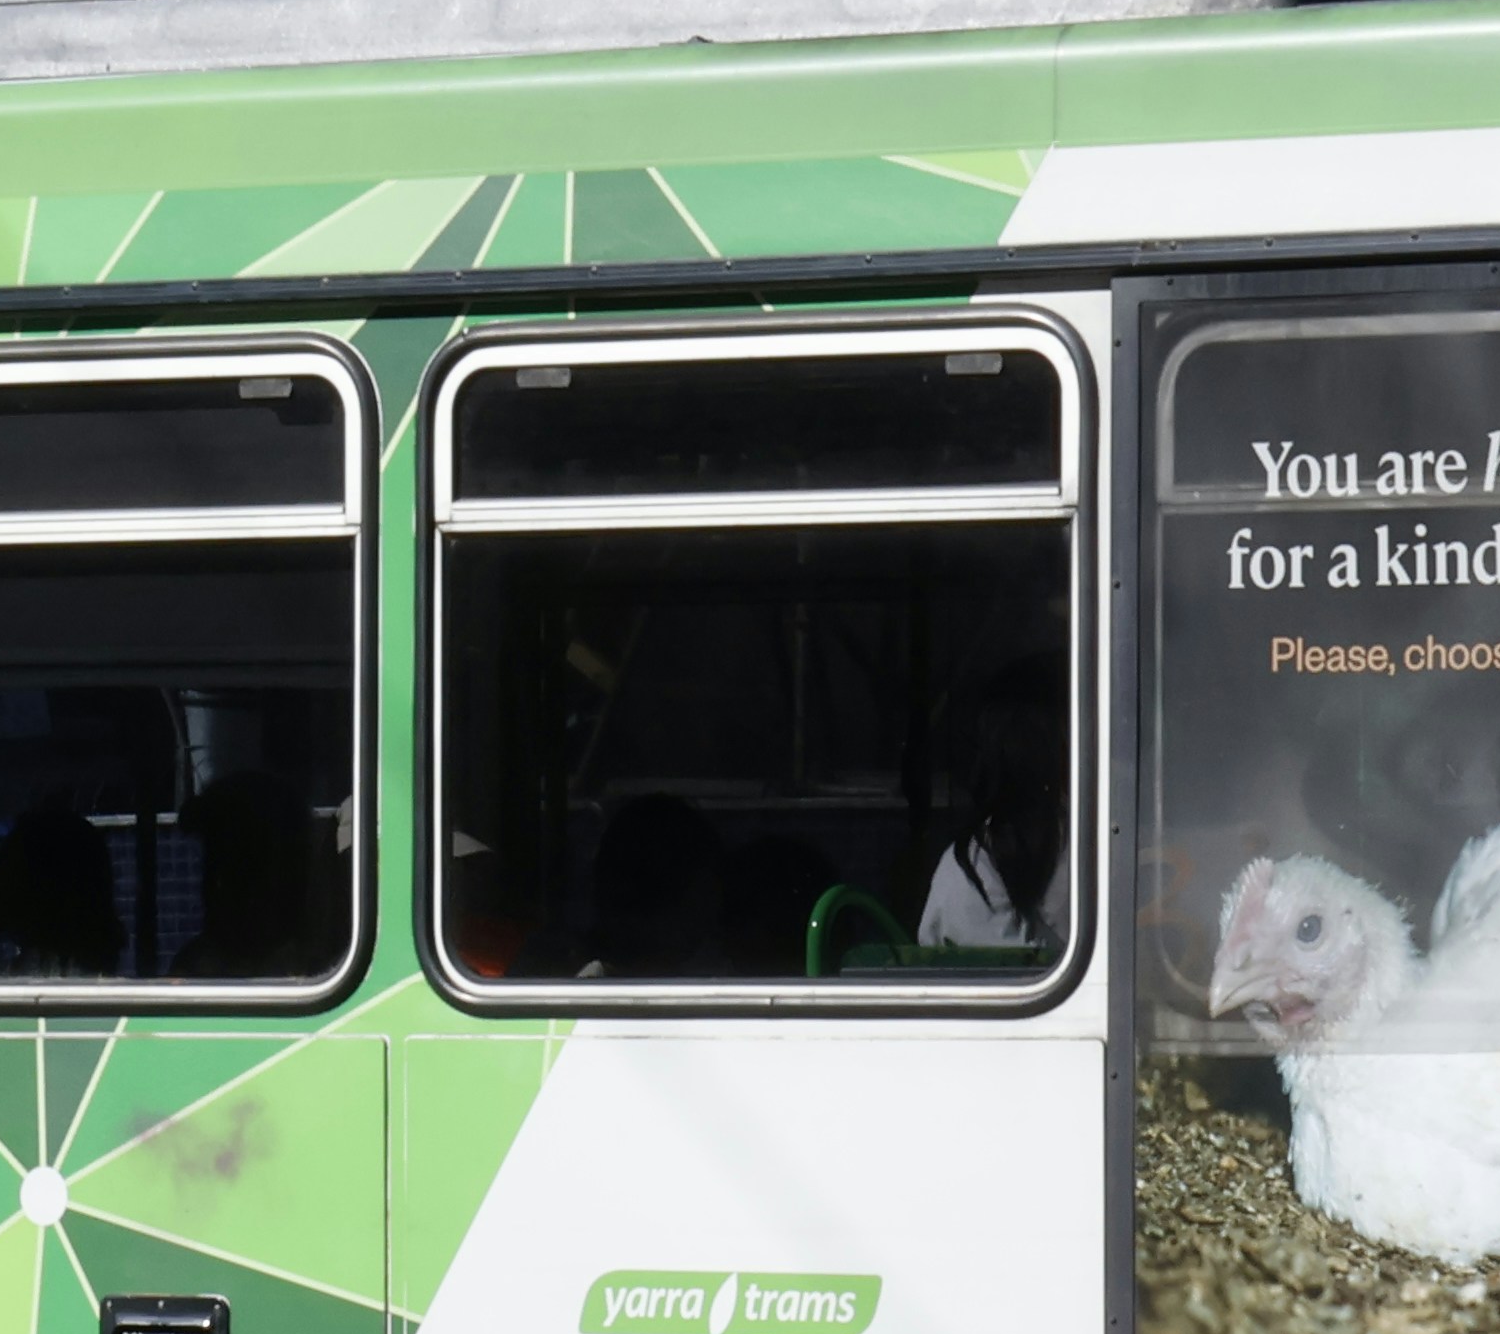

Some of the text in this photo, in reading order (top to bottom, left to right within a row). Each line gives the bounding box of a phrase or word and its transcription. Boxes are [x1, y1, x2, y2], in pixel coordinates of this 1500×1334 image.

[1252, 441, 1360, 499] You
[1376, 447, 1468, 496] are
[1227, 528, 1314, 590] for
[1326, 545, 1360, 588] a
[1270, 635, 1396, 676] Please,
[603, 1283, 857, 1327] yarra trams
